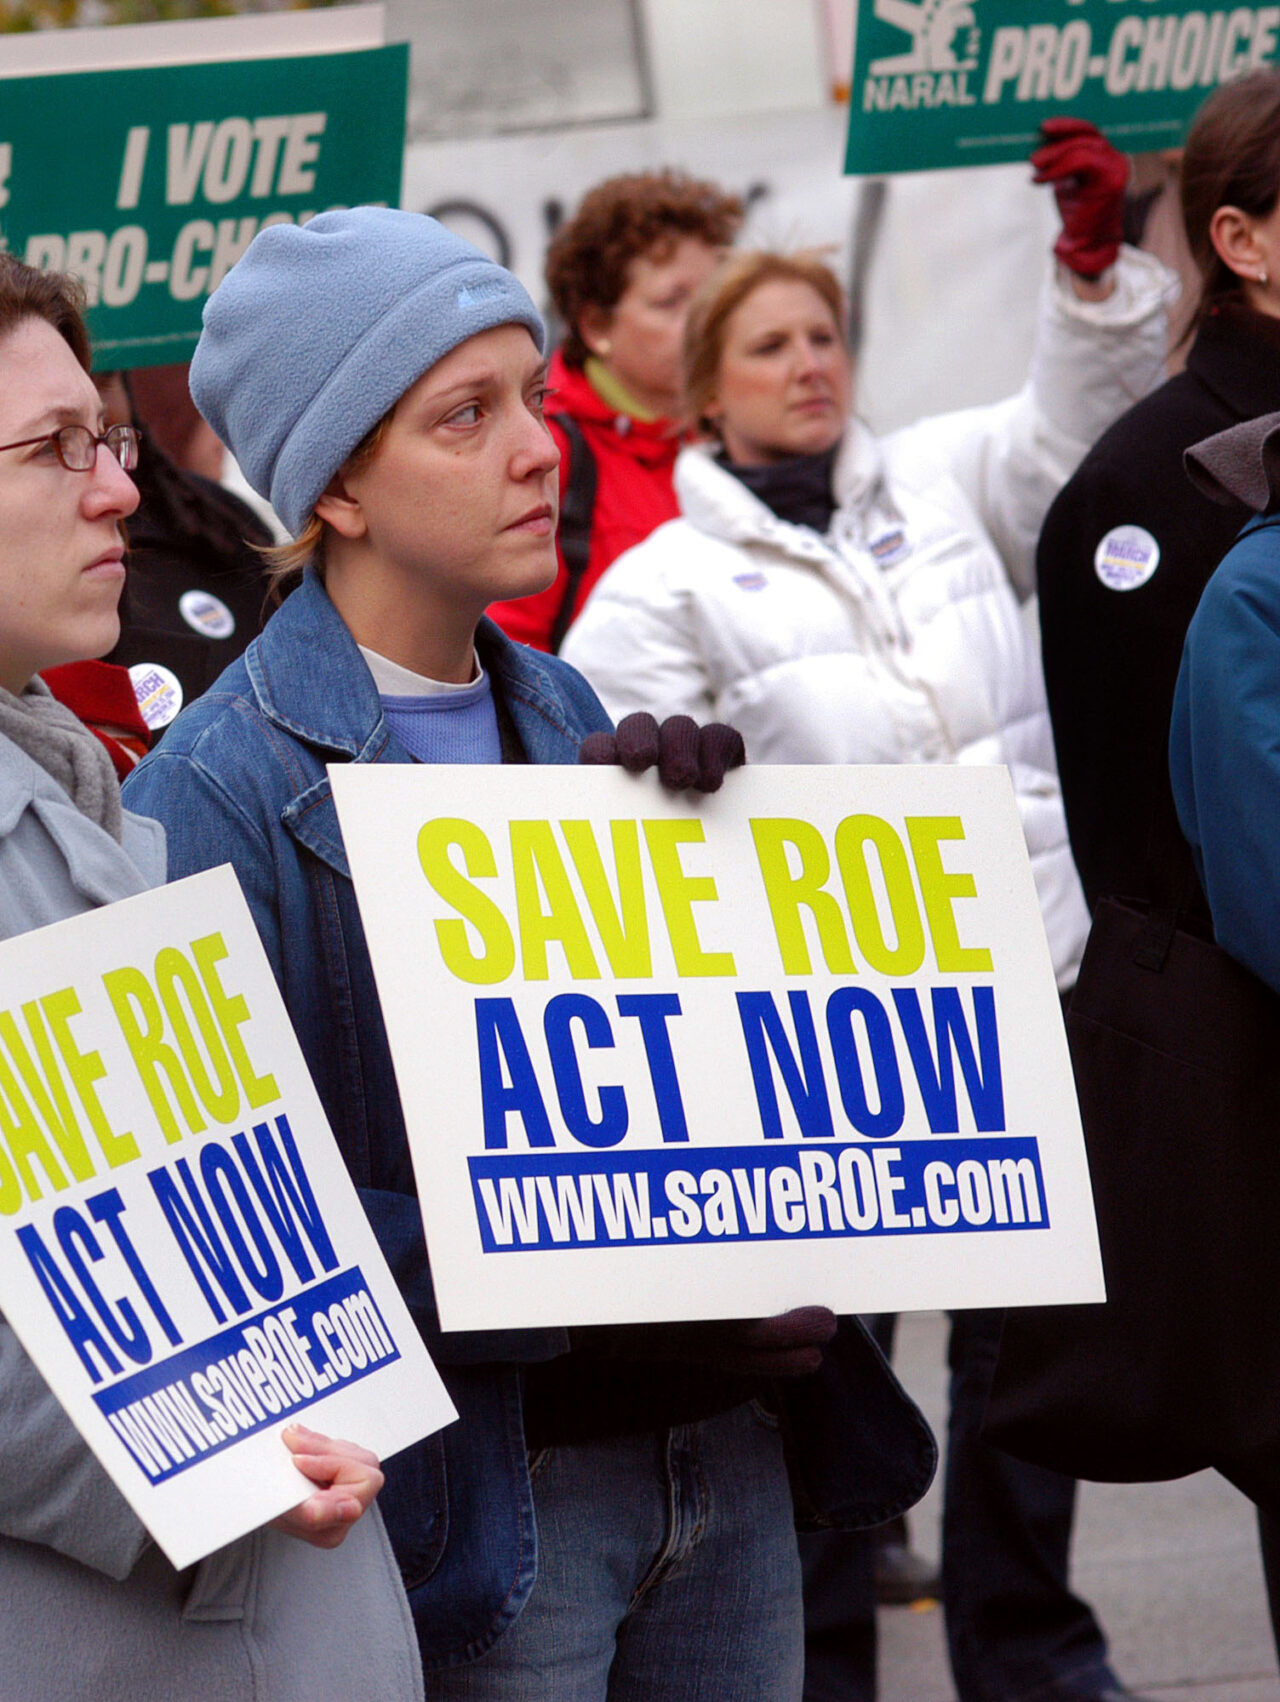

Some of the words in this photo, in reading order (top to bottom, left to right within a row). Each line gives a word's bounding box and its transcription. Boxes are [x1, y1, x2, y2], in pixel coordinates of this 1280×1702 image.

[863, 71, 976, 112] NARAL
[983, 6, 1280, 104] PRO-CHOICE
[117, 126, 150, 210] I
[166, 112, 327, 204] VOTE
[22, 202, 389, 308] PRO-CH
[416, 816, 738, 986] SAVE
[748, 813, 996, 977] ROE
[101, 932, 283, 1145] ROE
[473, 992, 691, 1150] ACT
[734, 985, 1008, 1141] NOW
[14, 1186, 184, 1386] ACT
[146, 1112, 341, 1326] NOW
[477, 1146, 1043, 1247] www.saveROE.com
[107, 1288, 393, 1479] www.saveROE.com
